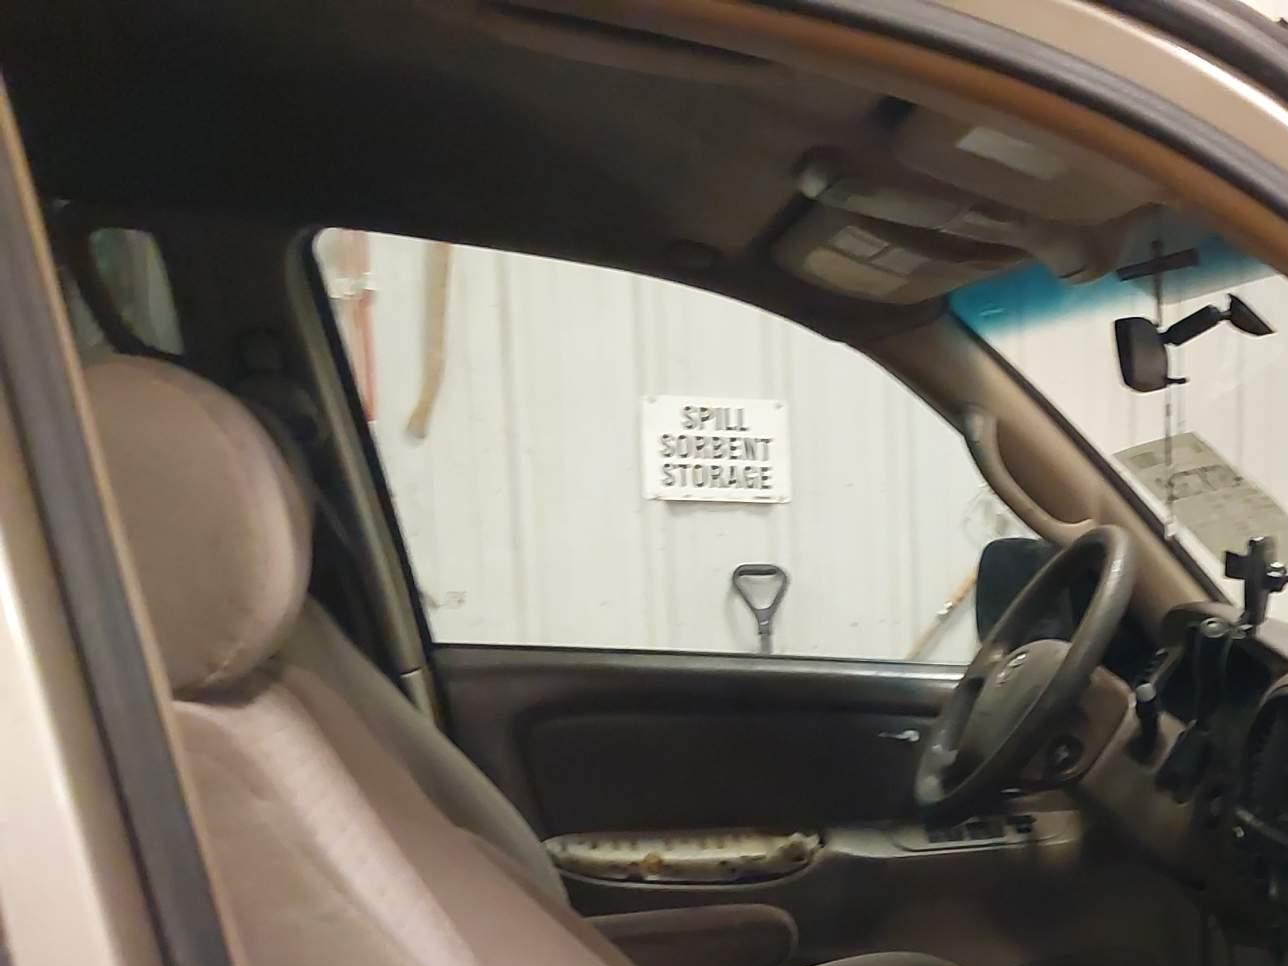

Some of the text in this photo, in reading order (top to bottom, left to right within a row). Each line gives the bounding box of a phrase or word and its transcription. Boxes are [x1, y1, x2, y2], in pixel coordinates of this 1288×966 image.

[681, 405, 751, 431] SPILL
[660, 433, 773, 461] SORBENT
[661, 462, 773, 490] STORAGE
